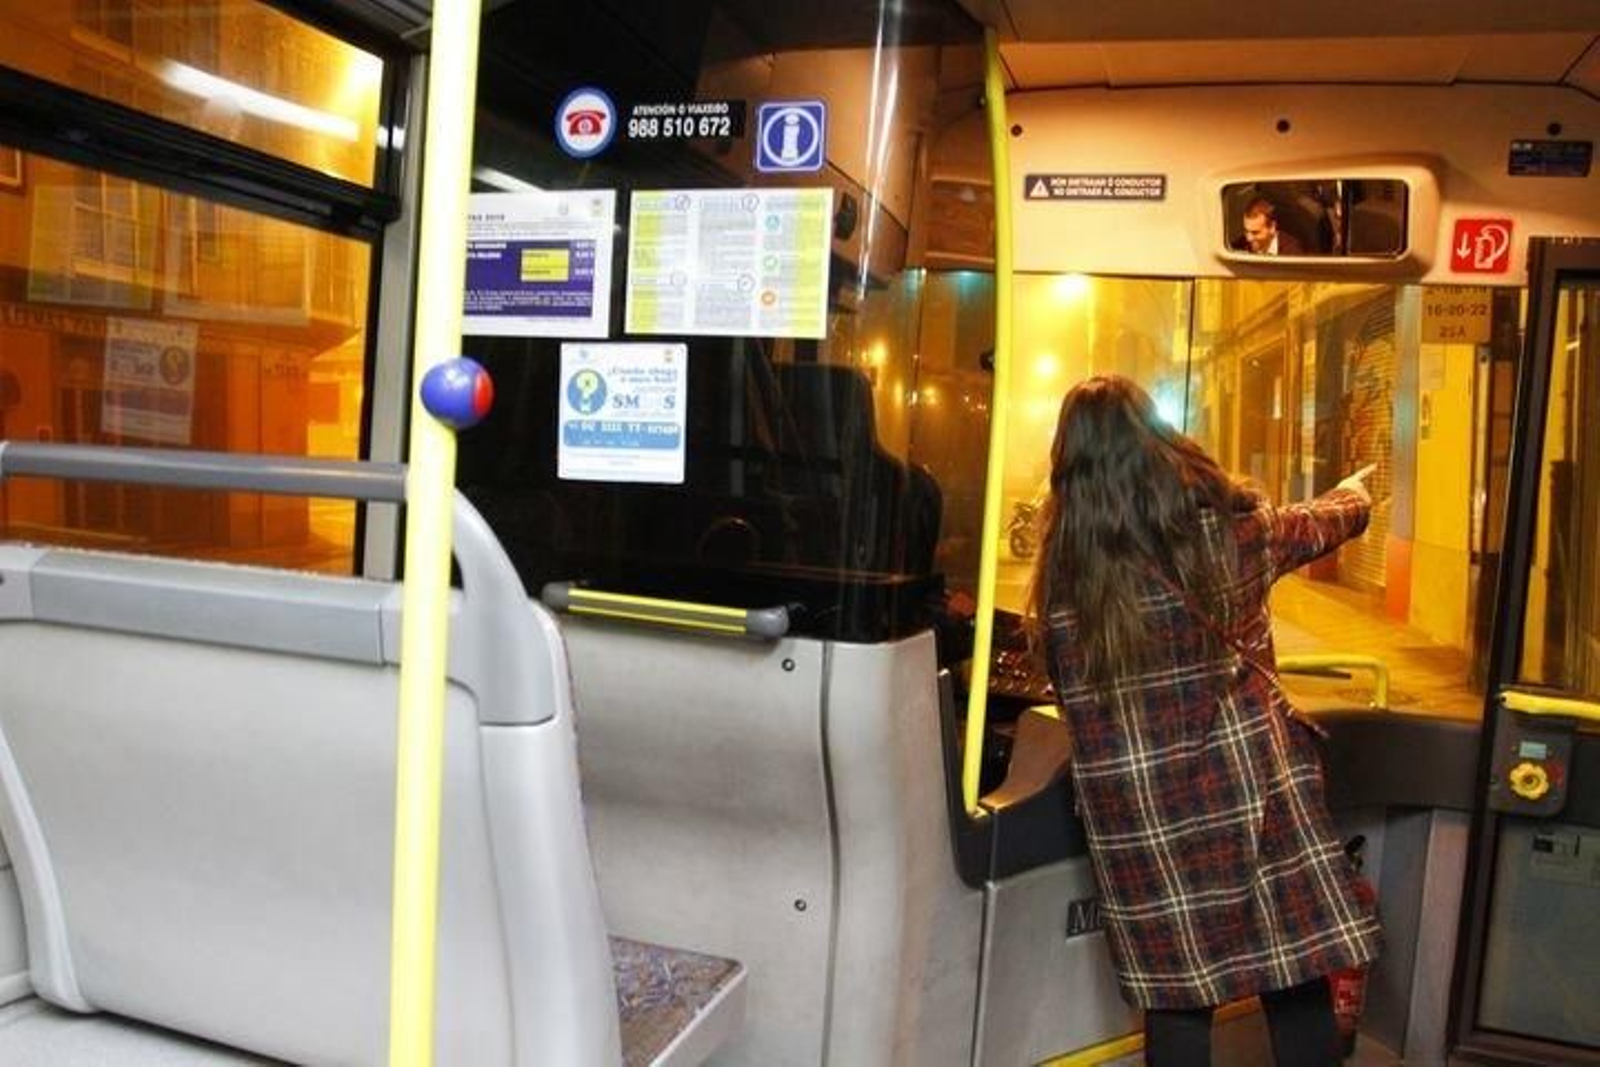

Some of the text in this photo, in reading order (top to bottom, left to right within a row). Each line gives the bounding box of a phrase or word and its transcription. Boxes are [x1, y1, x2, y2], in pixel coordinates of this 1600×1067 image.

[663, 117, 694, 137] 510
[699, 116, 731, 137] 672
[1114, 187, 1160, 197] CONDUCTOR
